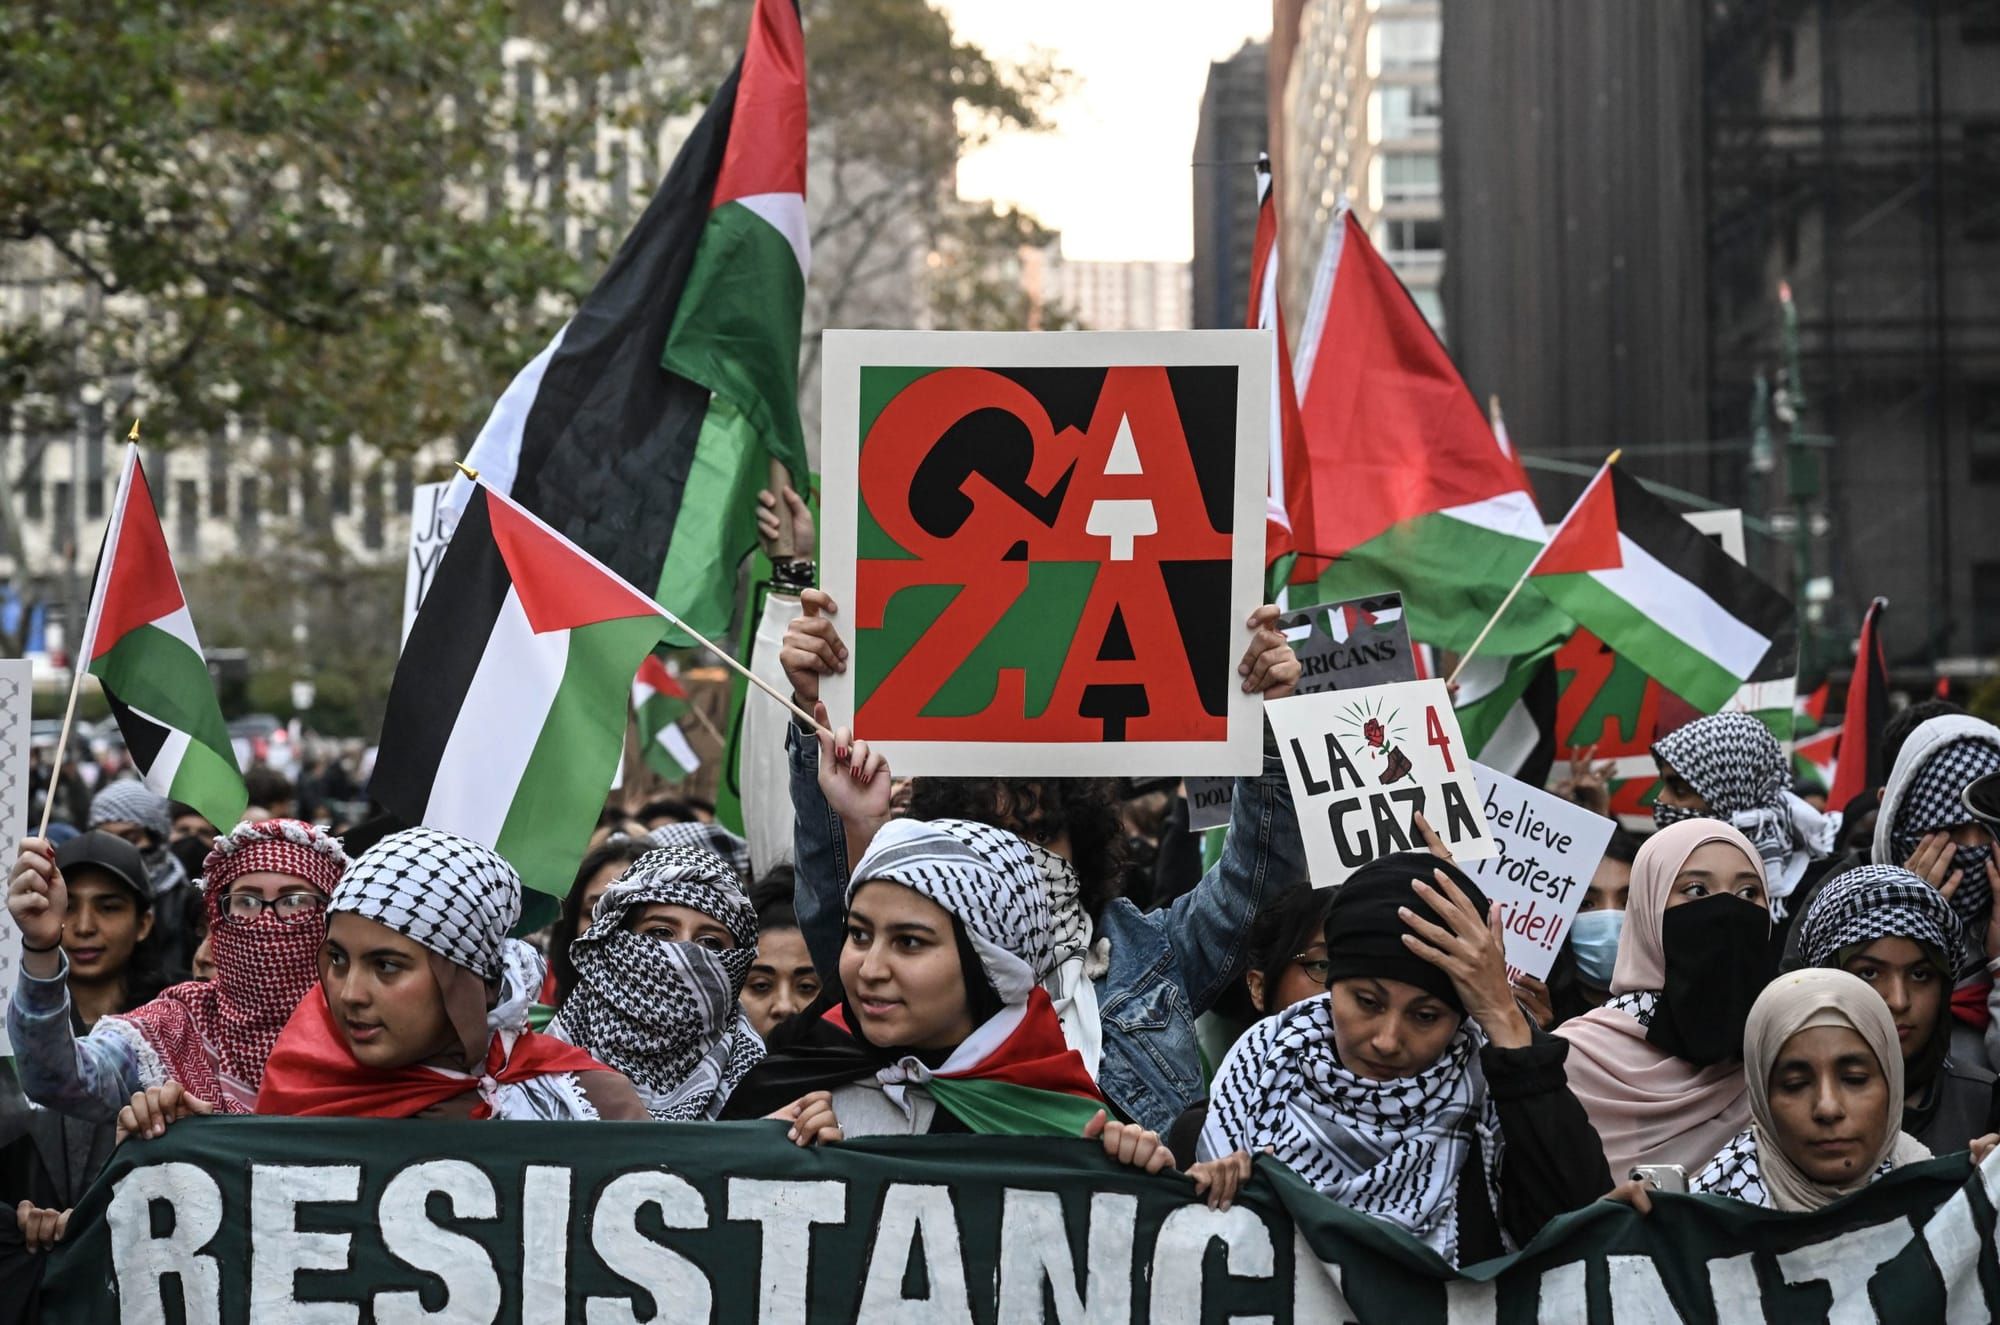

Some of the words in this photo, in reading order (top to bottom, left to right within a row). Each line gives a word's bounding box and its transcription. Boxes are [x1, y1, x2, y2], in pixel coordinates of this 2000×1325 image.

[1289, 733, 1366, 796] LA
[1426, 705, 1455, 773] 4
[1327, 781, 1482, 868] GAZA
[1483, 783, 1572, 854] believe
